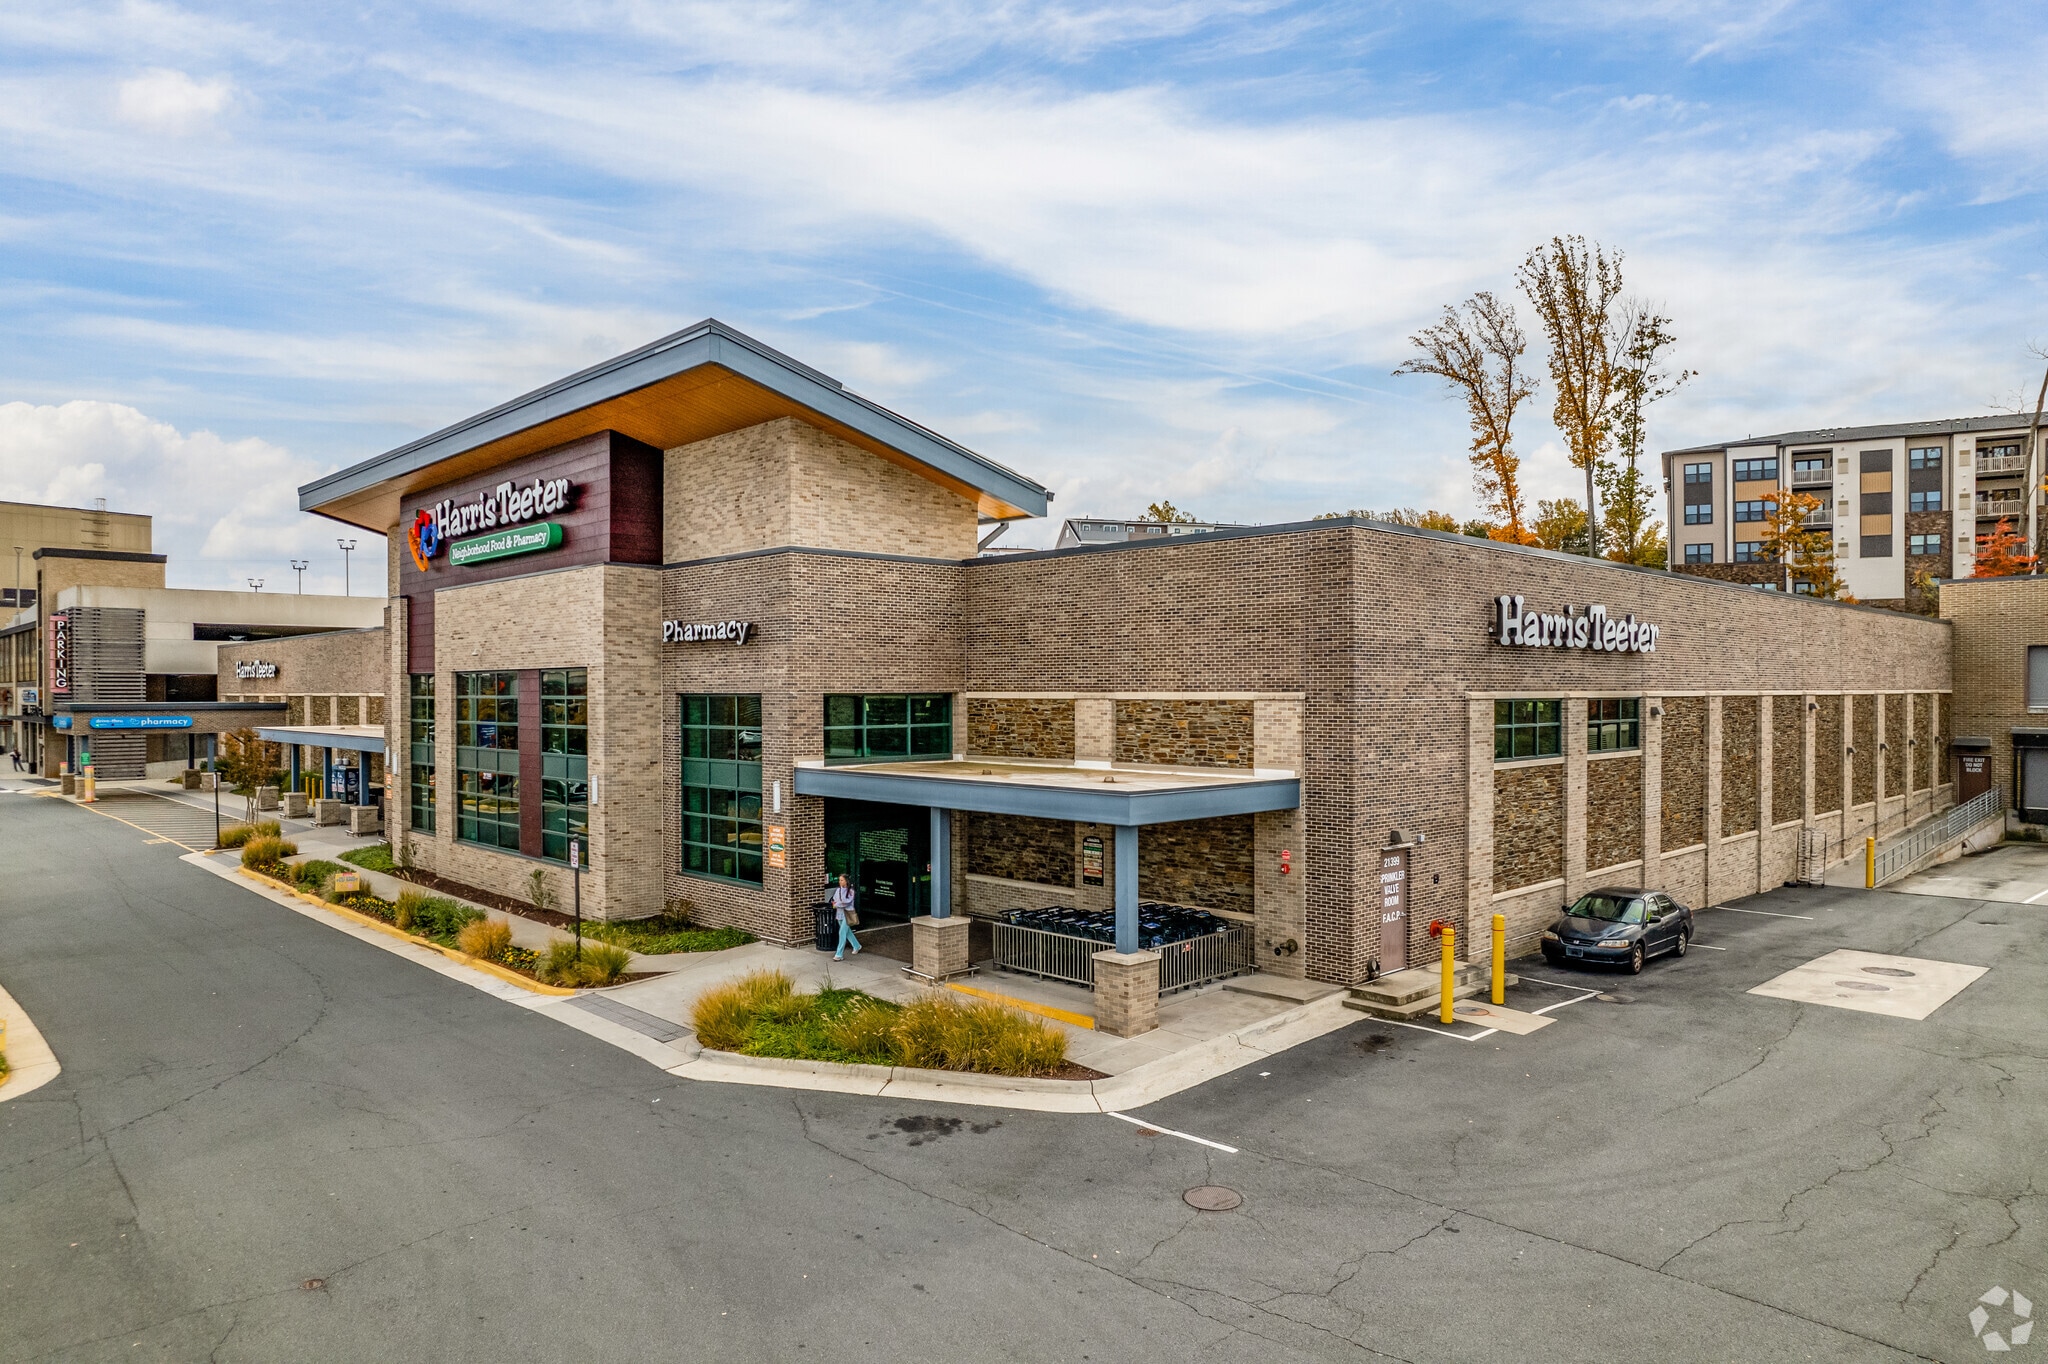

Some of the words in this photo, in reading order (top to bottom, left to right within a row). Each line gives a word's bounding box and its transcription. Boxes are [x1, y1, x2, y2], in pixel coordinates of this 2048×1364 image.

[435, 491, 497, 540] Harris
[496, 478, 569, 525] Teeter
[452, 540, 490, 561] Neighborhood
[490, 537, 506, 552] Food
[505, 535, 513, 549] &
[513, 532, 547, 547] Pharmacy
[662, 619, 749, 646] Pharmacy
[1500, 594, 1589, 648] Harris
[1589, 604, 1660, 653] Teeter
[56, 620, 67, 688] PARKING
[235, 660, 256, 679] Harris
[254, 659, 276, 679] Teeter
[140, 717, 188, 727] pharmacy
[1384, 883, 1399, 895] VALVE
[1384, 895, 1399, 908] ROOM
